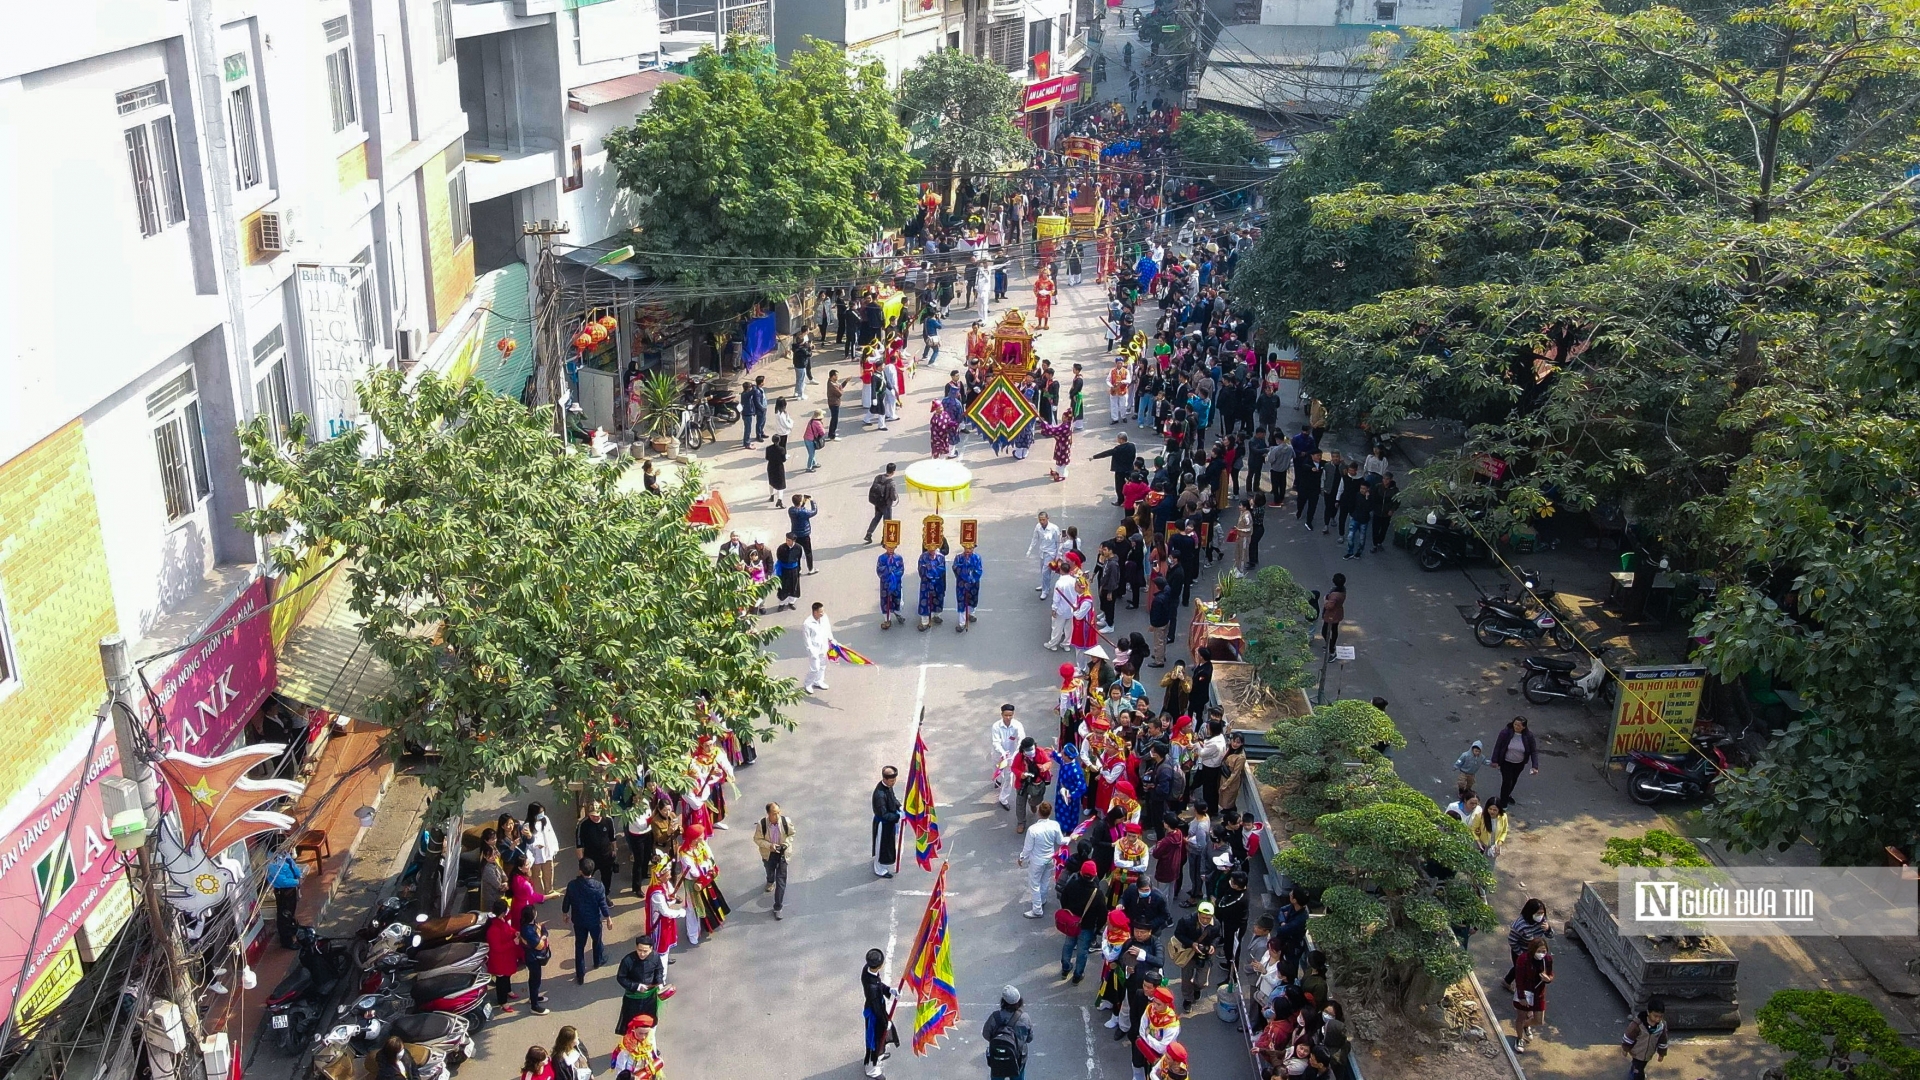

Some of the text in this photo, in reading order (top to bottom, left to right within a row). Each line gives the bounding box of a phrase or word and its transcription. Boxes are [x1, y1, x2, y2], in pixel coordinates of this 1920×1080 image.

[1628, 682, 1644, 691] BIA
[1646, 681, 1663, 691] HƠI
[1665, 680, 1679, 690] HÀ
[1619, 691, 1663, 726] LẨU
[0, 846, 18, 879] ÂN
[18, 813, 50, 856] HÀNG
[51, 781, 80, 821] NÔNG
[177, 656, 201, 687] NÔNG
[200, 634, 222, 662] THÔN
[237, 598, 255, 622] NAM
[1613, 727, 1663, 755] NƯỚNG
[36, 943, 53, 967] GIAO
[52, 925, 70, 948] DỊCH
